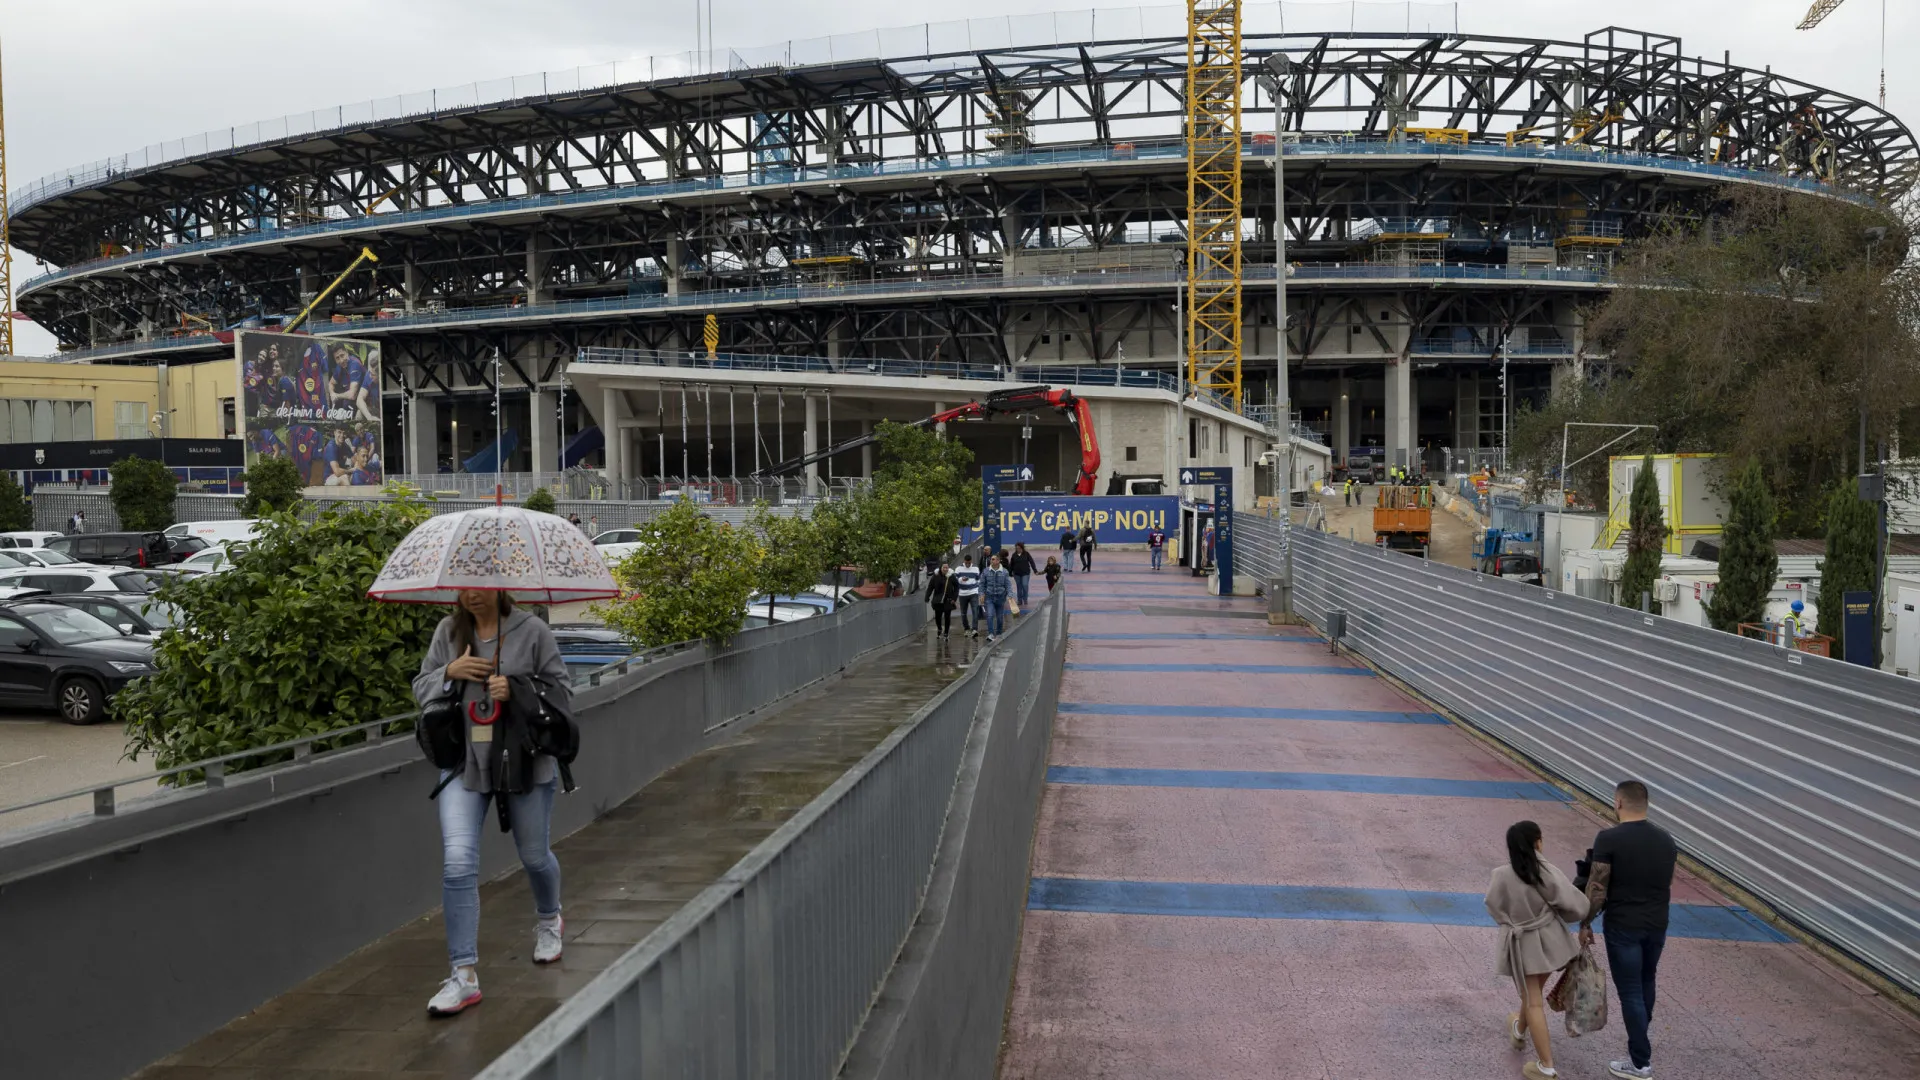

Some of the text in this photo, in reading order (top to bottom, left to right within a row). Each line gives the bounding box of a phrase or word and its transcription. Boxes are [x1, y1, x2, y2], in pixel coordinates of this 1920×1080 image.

[275, 401, 354, 425] definim el demà
[1041, 510, 1109, 531] CAMP
[1115, 510, 1165, 530] NOU
[450, 546, 533, 566] LOLA
